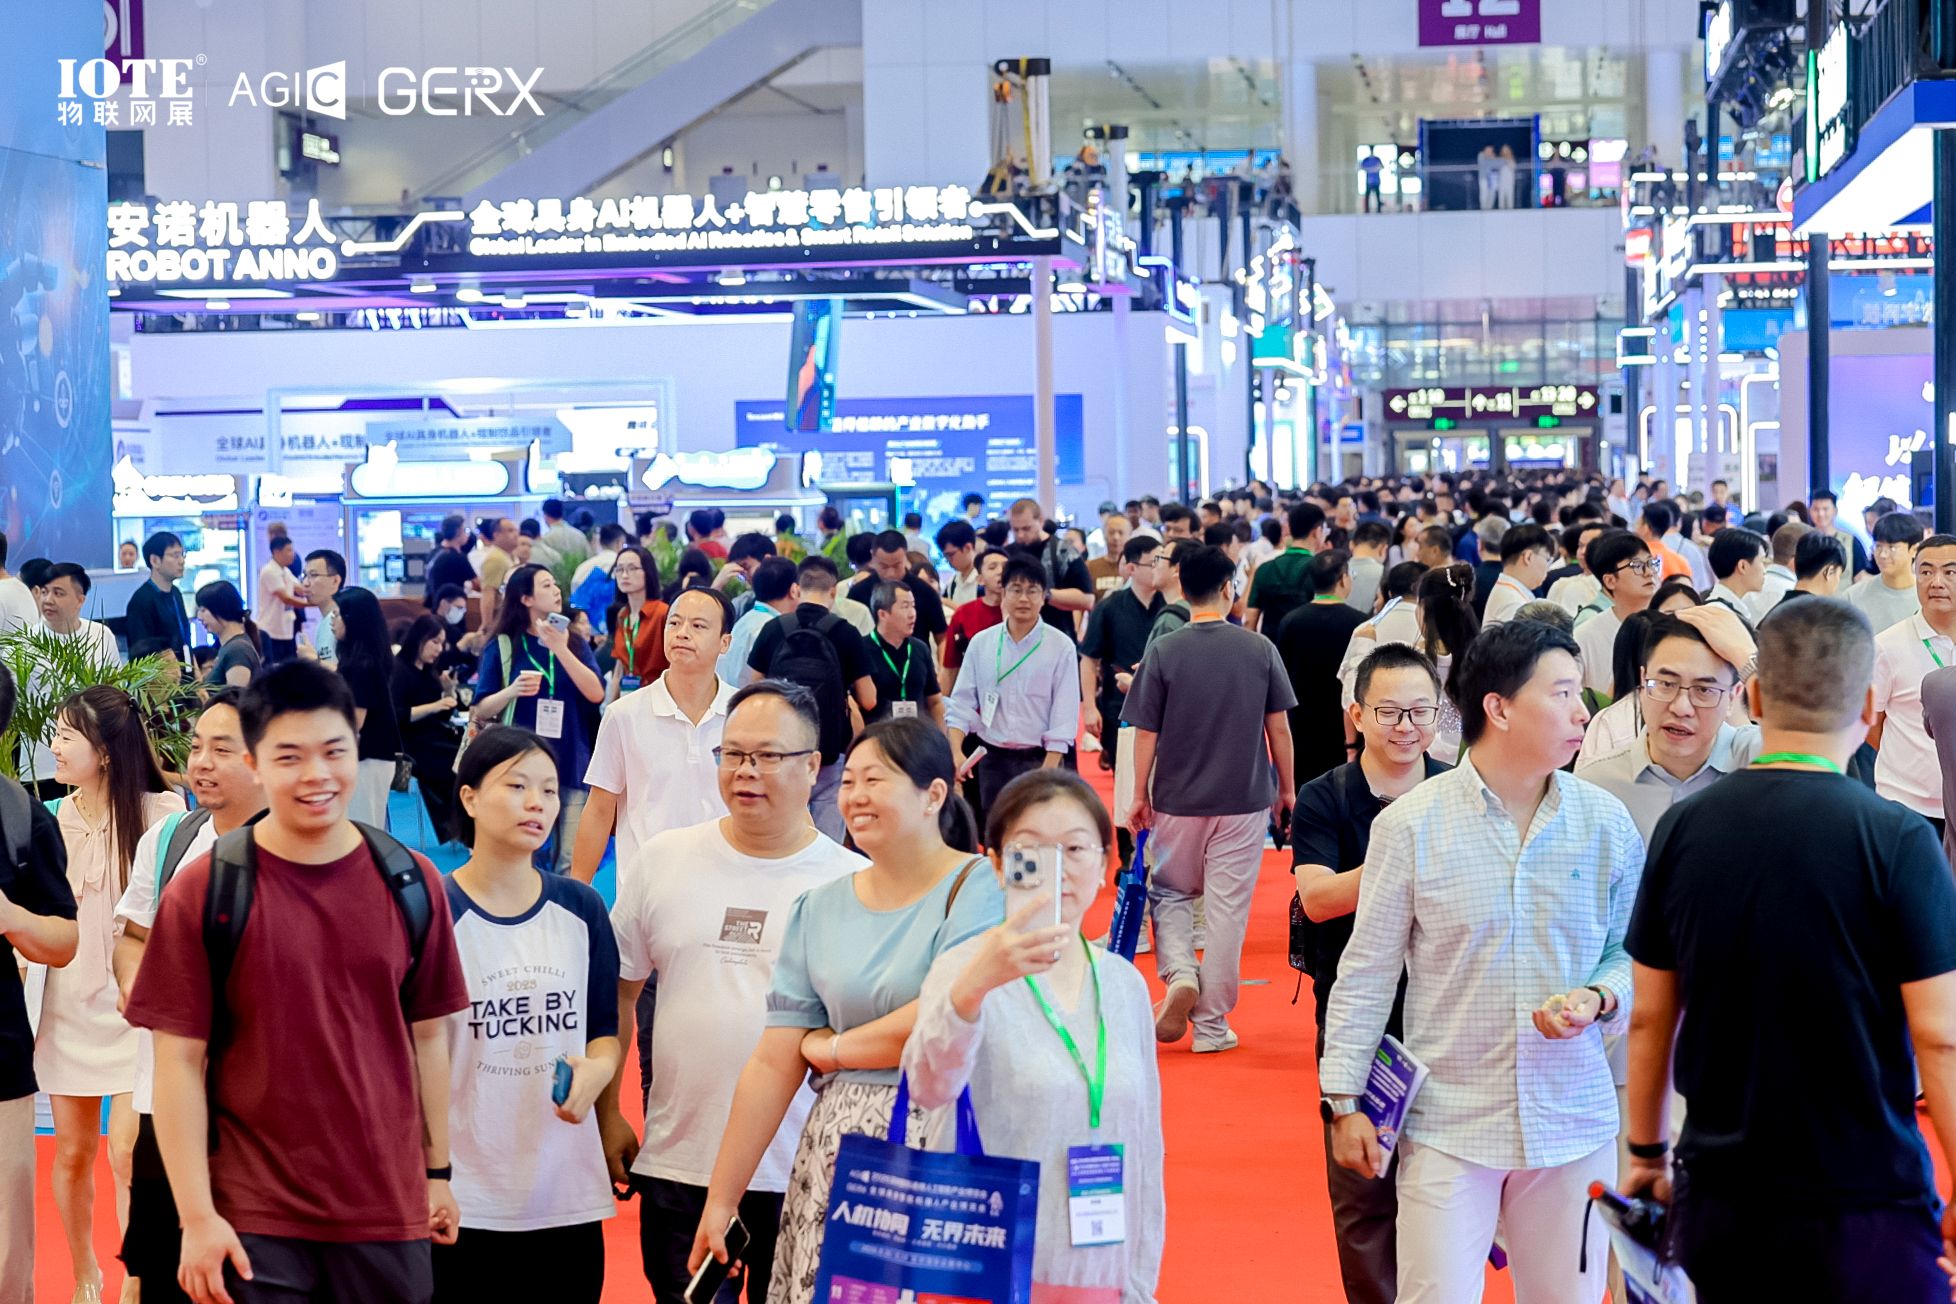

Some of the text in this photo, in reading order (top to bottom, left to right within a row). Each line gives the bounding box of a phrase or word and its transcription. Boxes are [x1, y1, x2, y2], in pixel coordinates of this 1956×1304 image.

[107, 198, 337, 248] 安诺机器人
[106, 247, 337, 281] ROBOT ANNO
[481, 965, 566, 986] SWEET CHILLI
[470, 989, 576, 1020] TAKE BY
[468, 1011, 577, 1039] TUCKING
[477, 1050, 568, 1076] THRIVING SUNY
[831, 1200, 910, 1237] 人机协同
[920, 1217, 1007, 1249] 无界未来
